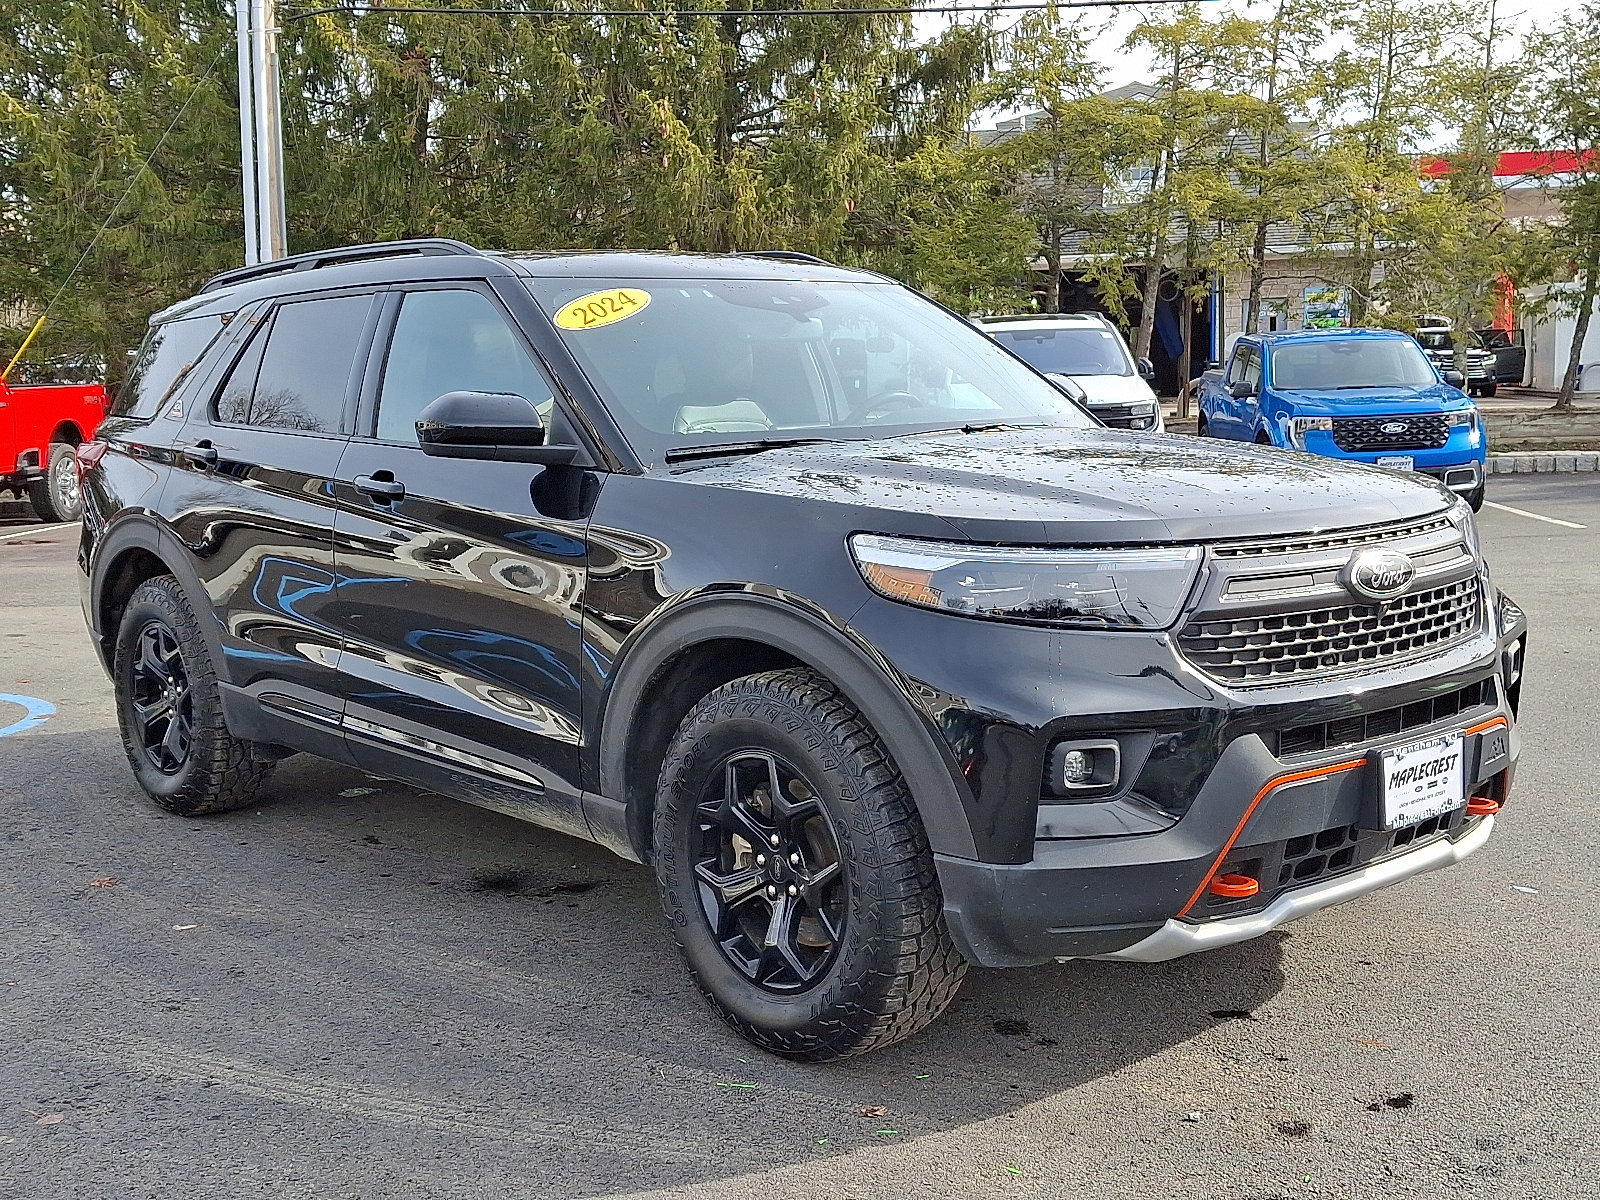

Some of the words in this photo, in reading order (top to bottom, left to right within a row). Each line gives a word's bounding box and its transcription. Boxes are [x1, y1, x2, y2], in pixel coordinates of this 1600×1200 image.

[573, 291, 638, 325] 2024
[1370, 560, 1406, 589] Ford
[1445, 732, 1459, 746] NJ
[670, 731, 712, 799] SPORT
[1388, 753, 1459, 790] MAPLECREST
[663, 801, 688, 928] OPTIMUM
